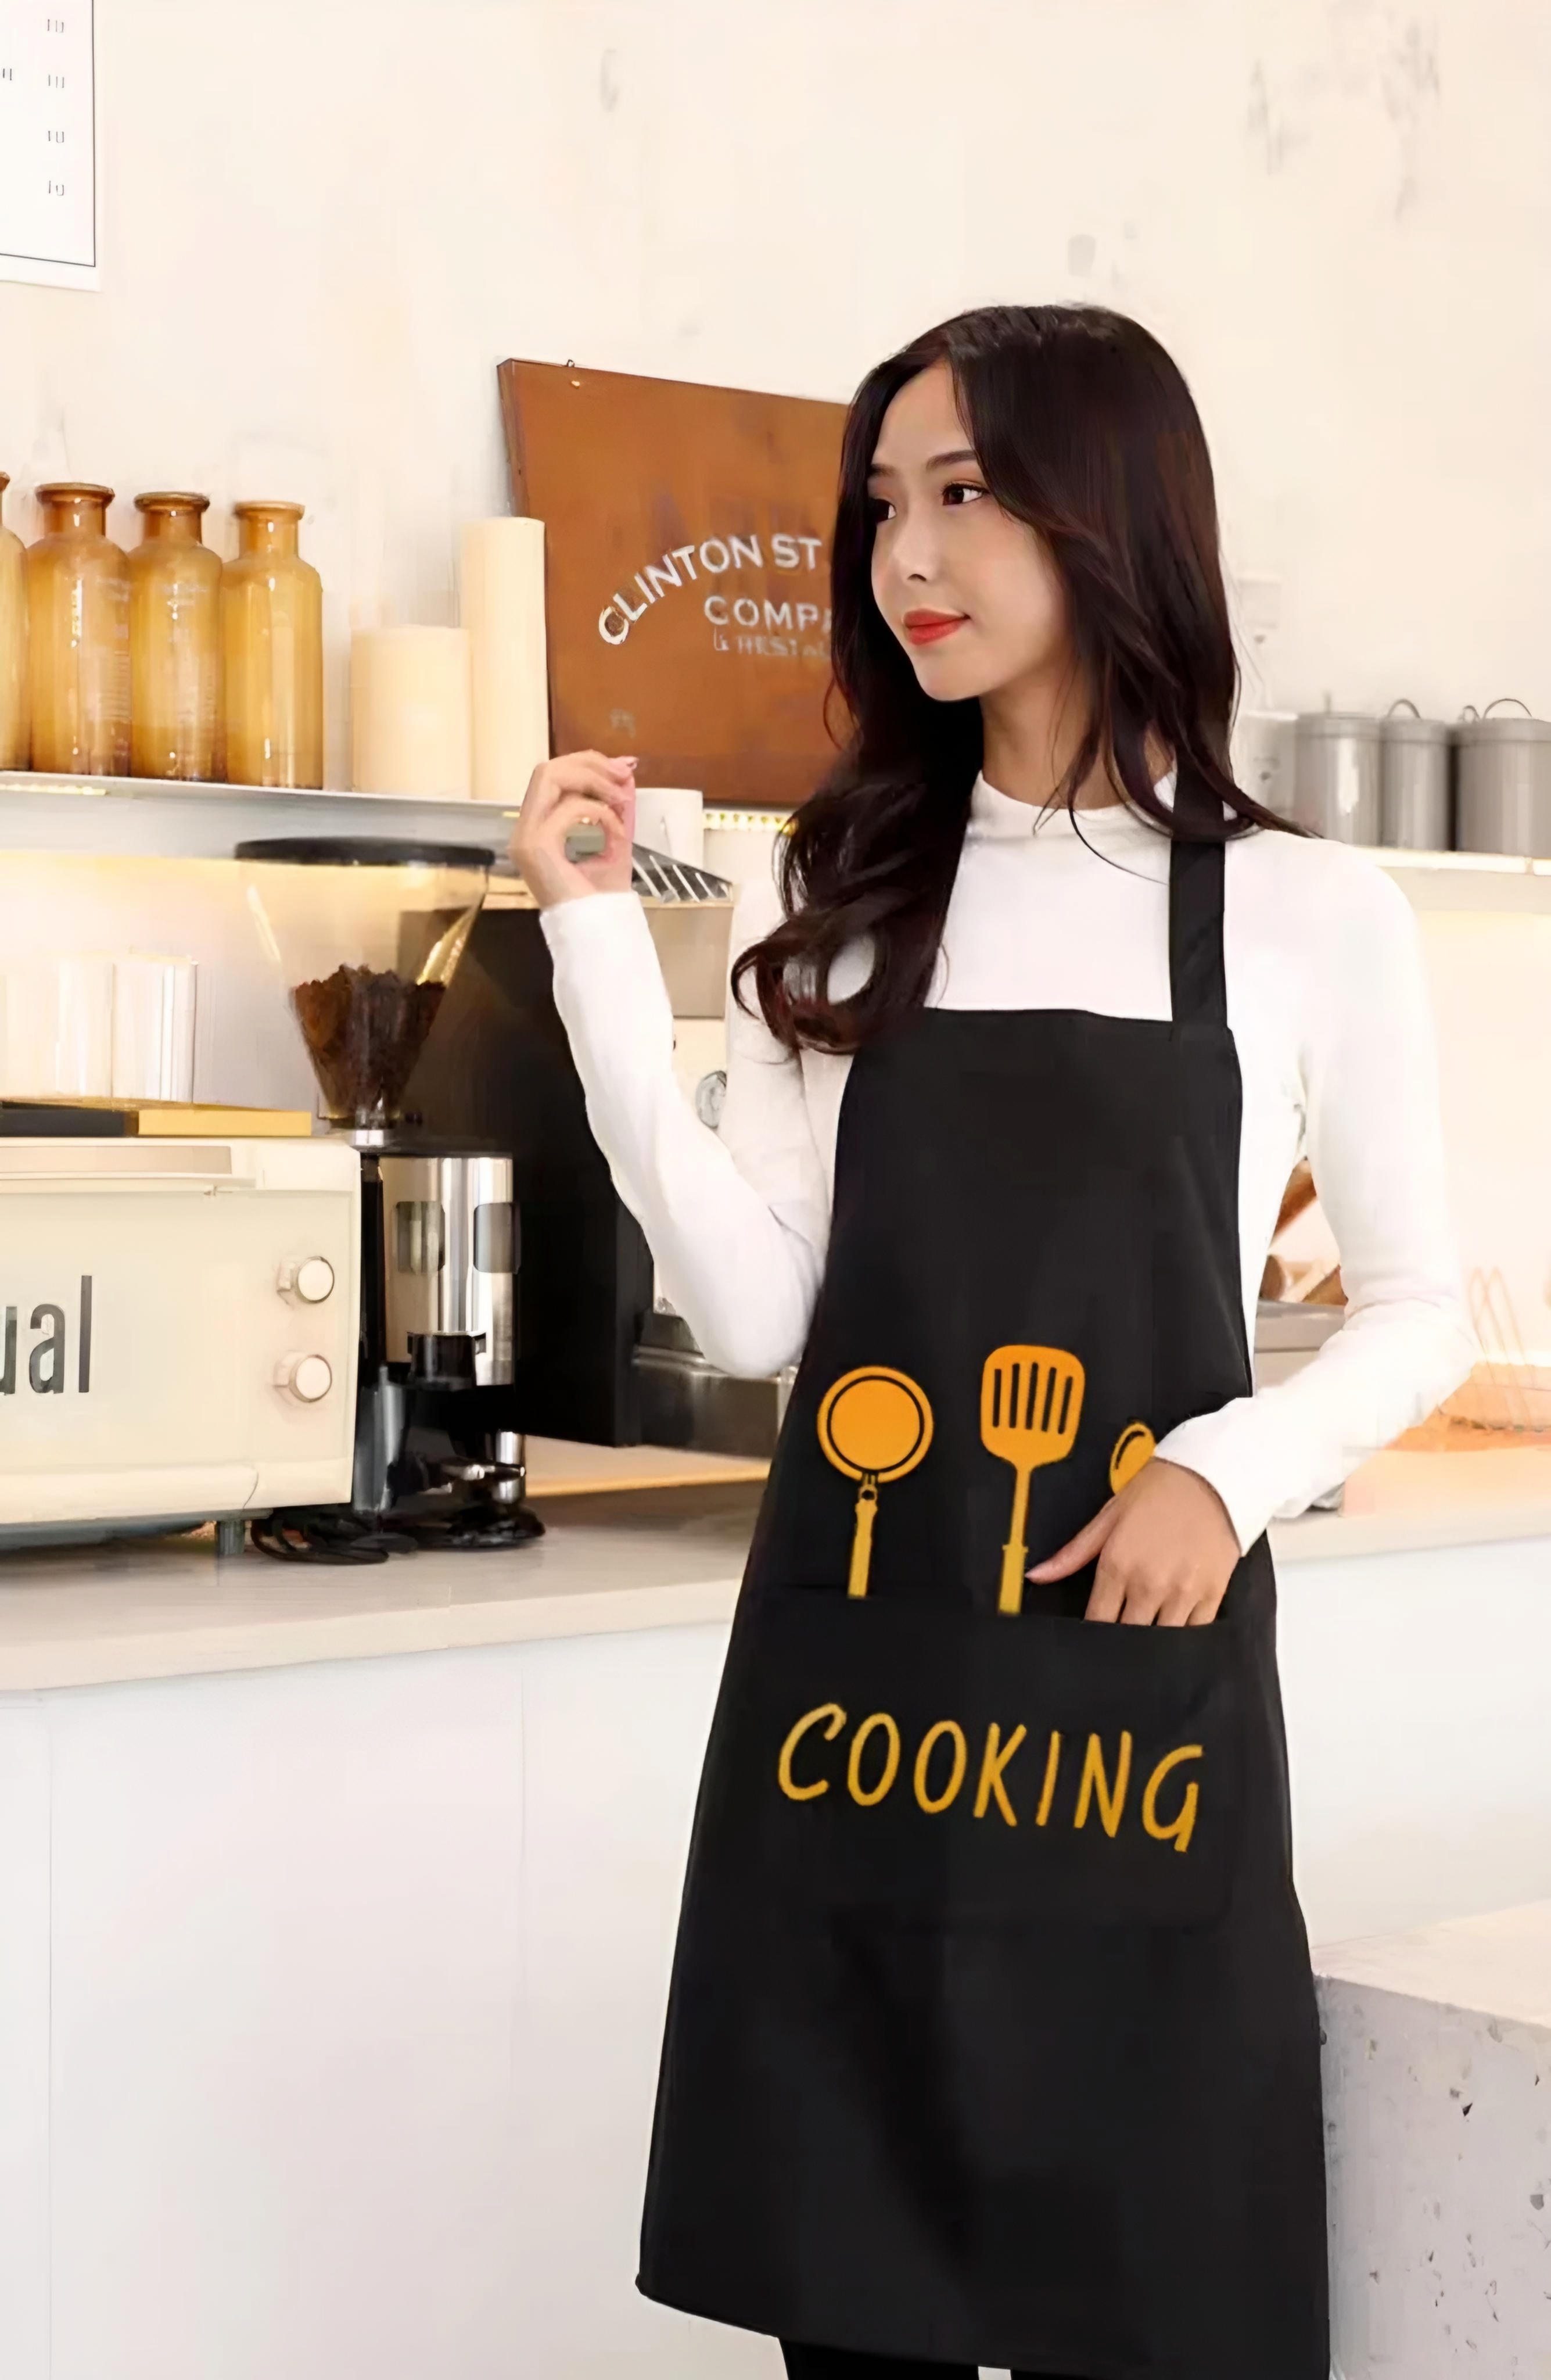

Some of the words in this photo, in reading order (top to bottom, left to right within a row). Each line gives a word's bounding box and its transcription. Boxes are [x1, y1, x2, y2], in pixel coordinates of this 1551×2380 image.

[598, 534, 763, 646] CLINTON
[771, 533, 822, 569] ST
[778, 1703, 1203, 1852] COOKING
